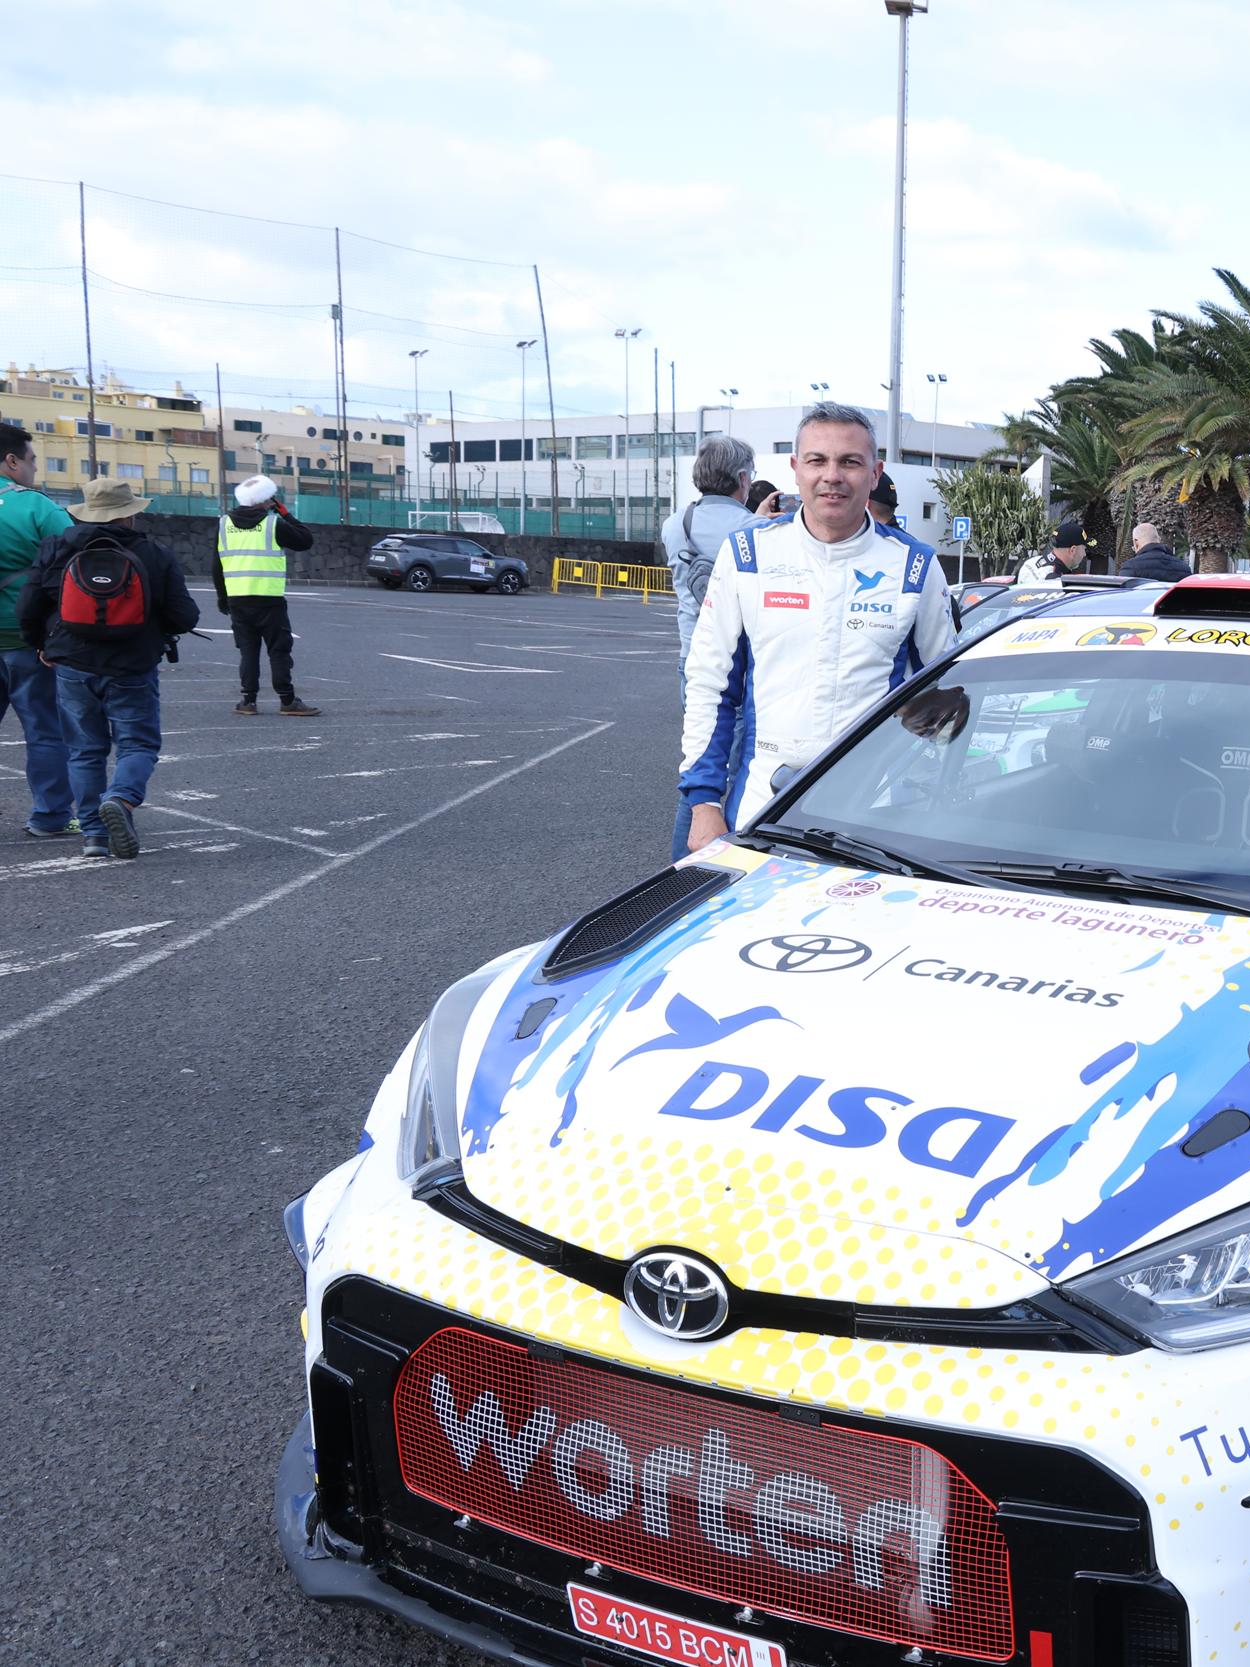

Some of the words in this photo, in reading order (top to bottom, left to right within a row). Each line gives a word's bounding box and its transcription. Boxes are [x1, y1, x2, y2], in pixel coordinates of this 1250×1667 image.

[956, 523, 967, 537] P
[735, 531, 752, 563] sparco
[769, 596, 805, 606] worten
[850, 602, 893, 614] DISA
[868, 621, 895, 631] Canarias
[1011, 629, 1060, 644] NAPA
[1087, 736, 1111, 750] OMP
[917, 894, 1048, 921] deporte
[1052, 910, 1205, 945] lagunero
[935, 887, 1022, 906] Organismo
[1115, 910, 1136, 921] de
[1140, 913, 1218, 934] Deportes
[904, 958, 1125, 1008] Canarias
[658, 1060, 1018, 1179] DISA
[430, 1373, 952, 1607] worten
[577, 1597, 599, 1627] S
[605, 1607, 672, 1650] 4015
[679, 1628, 749, 1667] BCM
